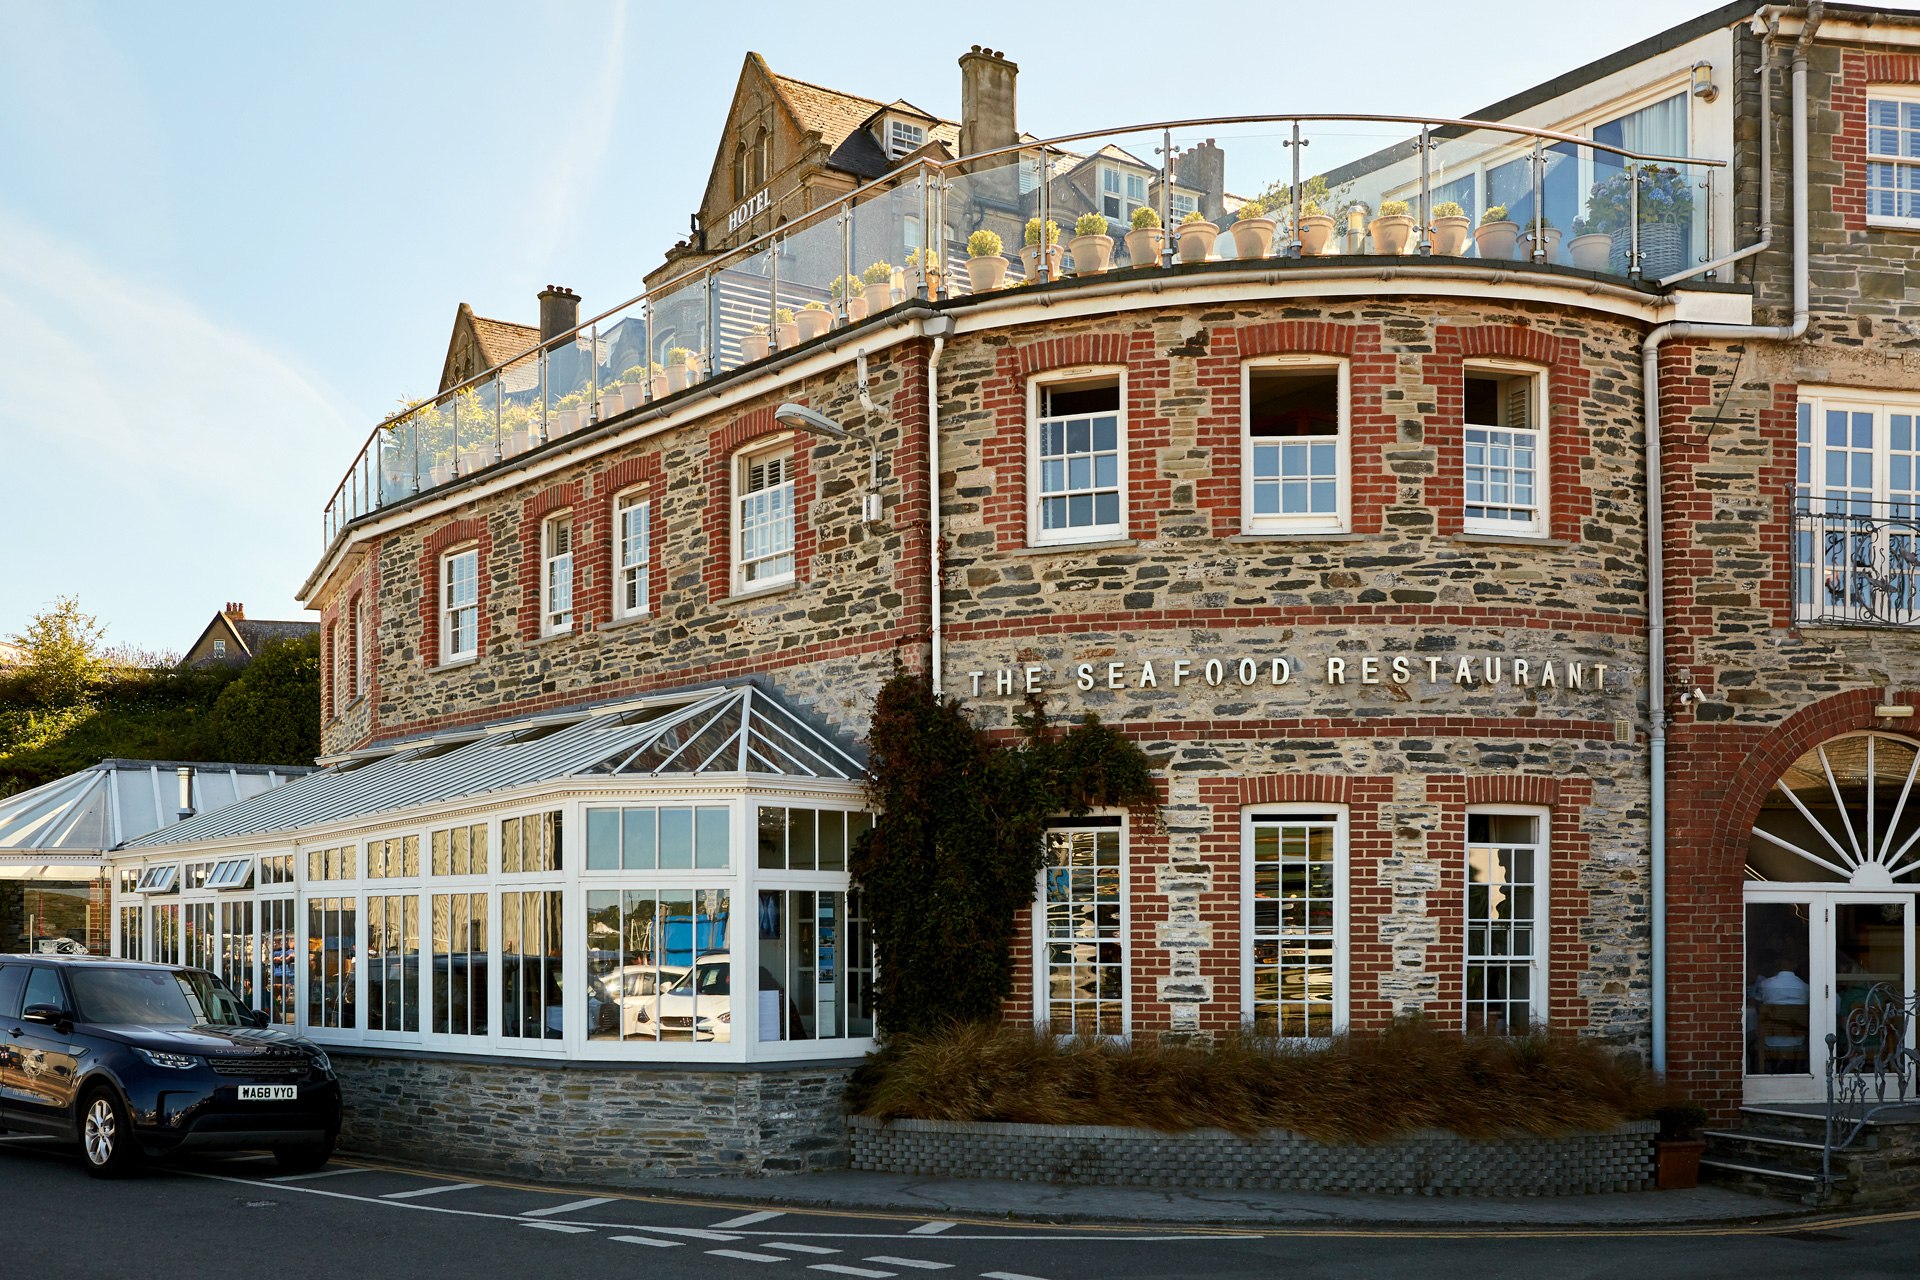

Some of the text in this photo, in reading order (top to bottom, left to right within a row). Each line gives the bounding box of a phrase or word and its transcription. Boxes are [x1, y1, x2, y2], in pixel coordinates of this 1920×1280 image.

[728, 187, 771, 233] HOTEL
[969, 656, 1608, 697] THE SEAFOOD RESTAURANT
[243, 1087, 294, 1098] WA68 VYO
